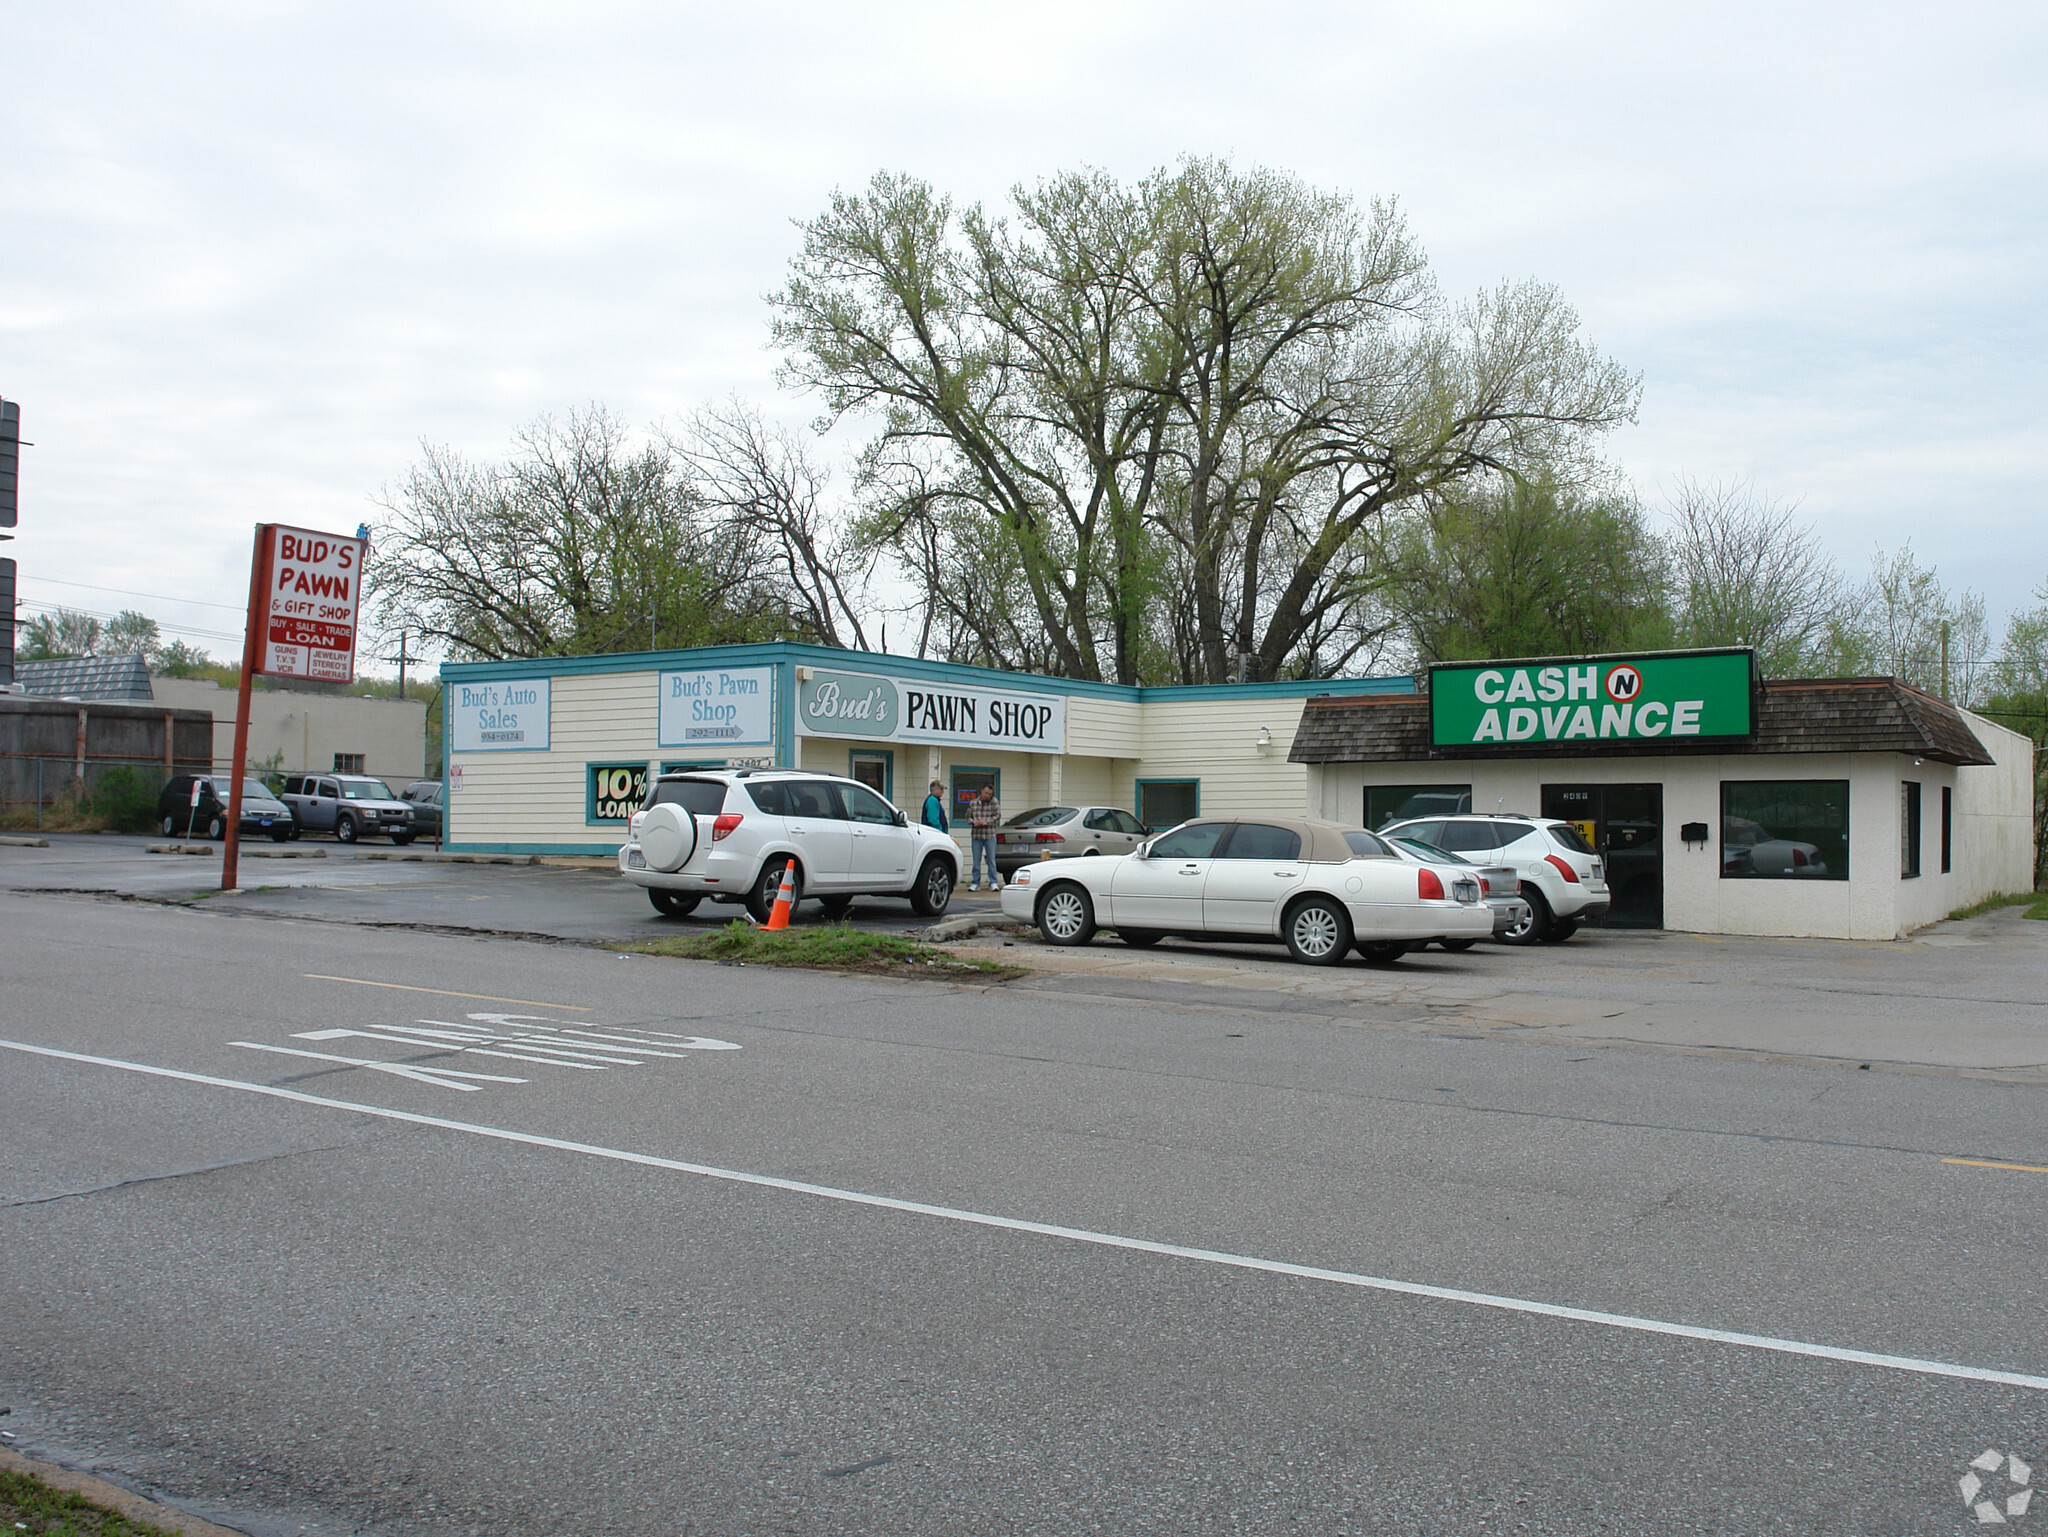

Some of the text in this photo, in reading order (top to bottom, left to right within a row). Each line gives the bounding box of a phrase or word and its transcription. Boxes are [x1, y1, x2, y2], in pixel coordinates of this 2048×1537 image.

[281, 535, 354, 569] BUD'S
[279, 567, 349, 601] PAWN
[271, 599, 351, 620] & GIFT SHOP
[271, 618, 352, 637] BUY SALE TRADE
[285, 631, 335, 646] LOAN
[274, 645, 298, 655] GUNS
[313, 650, 348, 661] JEWELRY
[276, 664, 294, 673] VCR
[311, 668, 347, 680] CAMERAS
[312, 660, 347, 671] STEREO'S
[671, 672, 760, 698] Bud's Pawn
[1474, 666, 1635, 704] CASH N
[461, 685, 537, 708] Bud's Auto
[478, 708, 518, 730] Sales
[691, 699, 737, 726] Shop
[808, 680, 1053, 740] Bud's PAWN SHOP
[1472, 700, 1704, 742] ADVANCE
